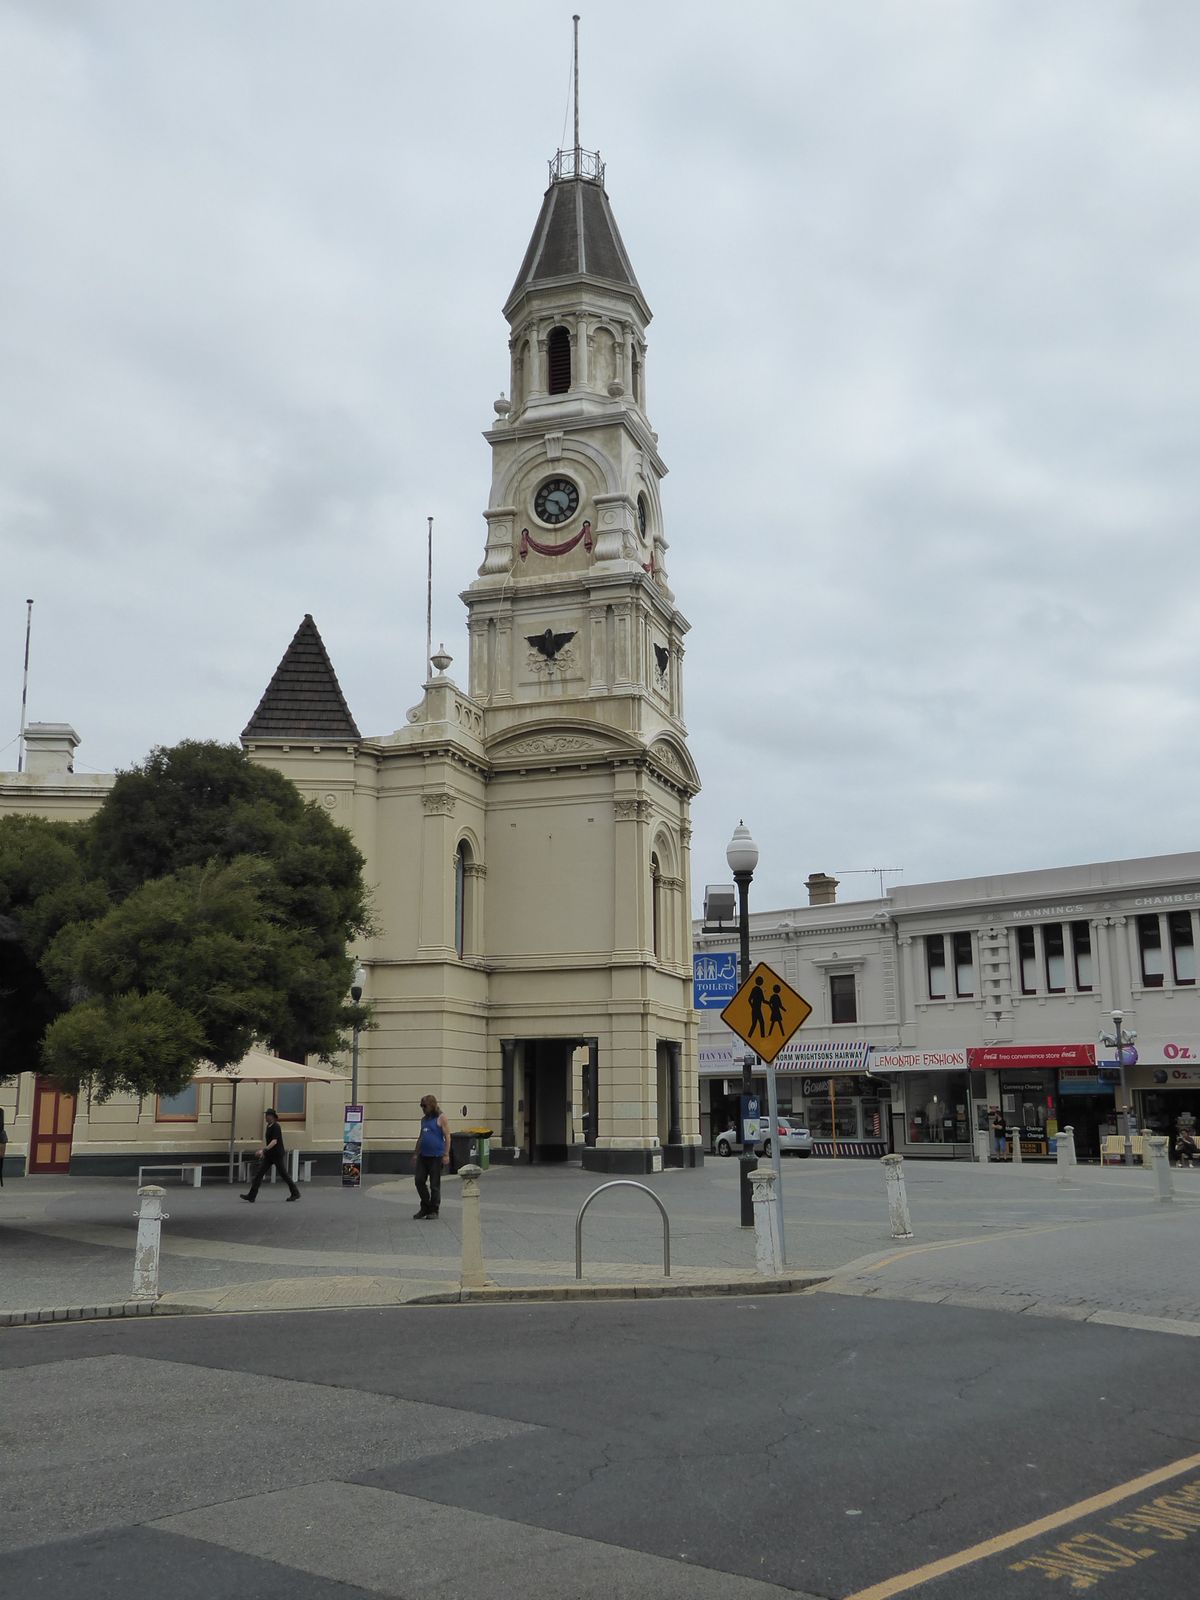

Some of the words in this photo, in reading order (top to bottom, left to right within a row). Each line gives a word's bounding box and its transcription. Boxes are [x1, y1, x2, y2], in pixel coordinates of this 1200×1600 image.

[1013, 904, 1084, 919] MANNING'S
[697, 983, 734, 991] TOILETS
[776, 1054, 793, 1062] NORM
[794, 1052, 833, 1061] WRIGHTSONS
[874, 1054, 920, 1067] LEMONADE
[923, 1052, 964, 1067] FASHIONS
